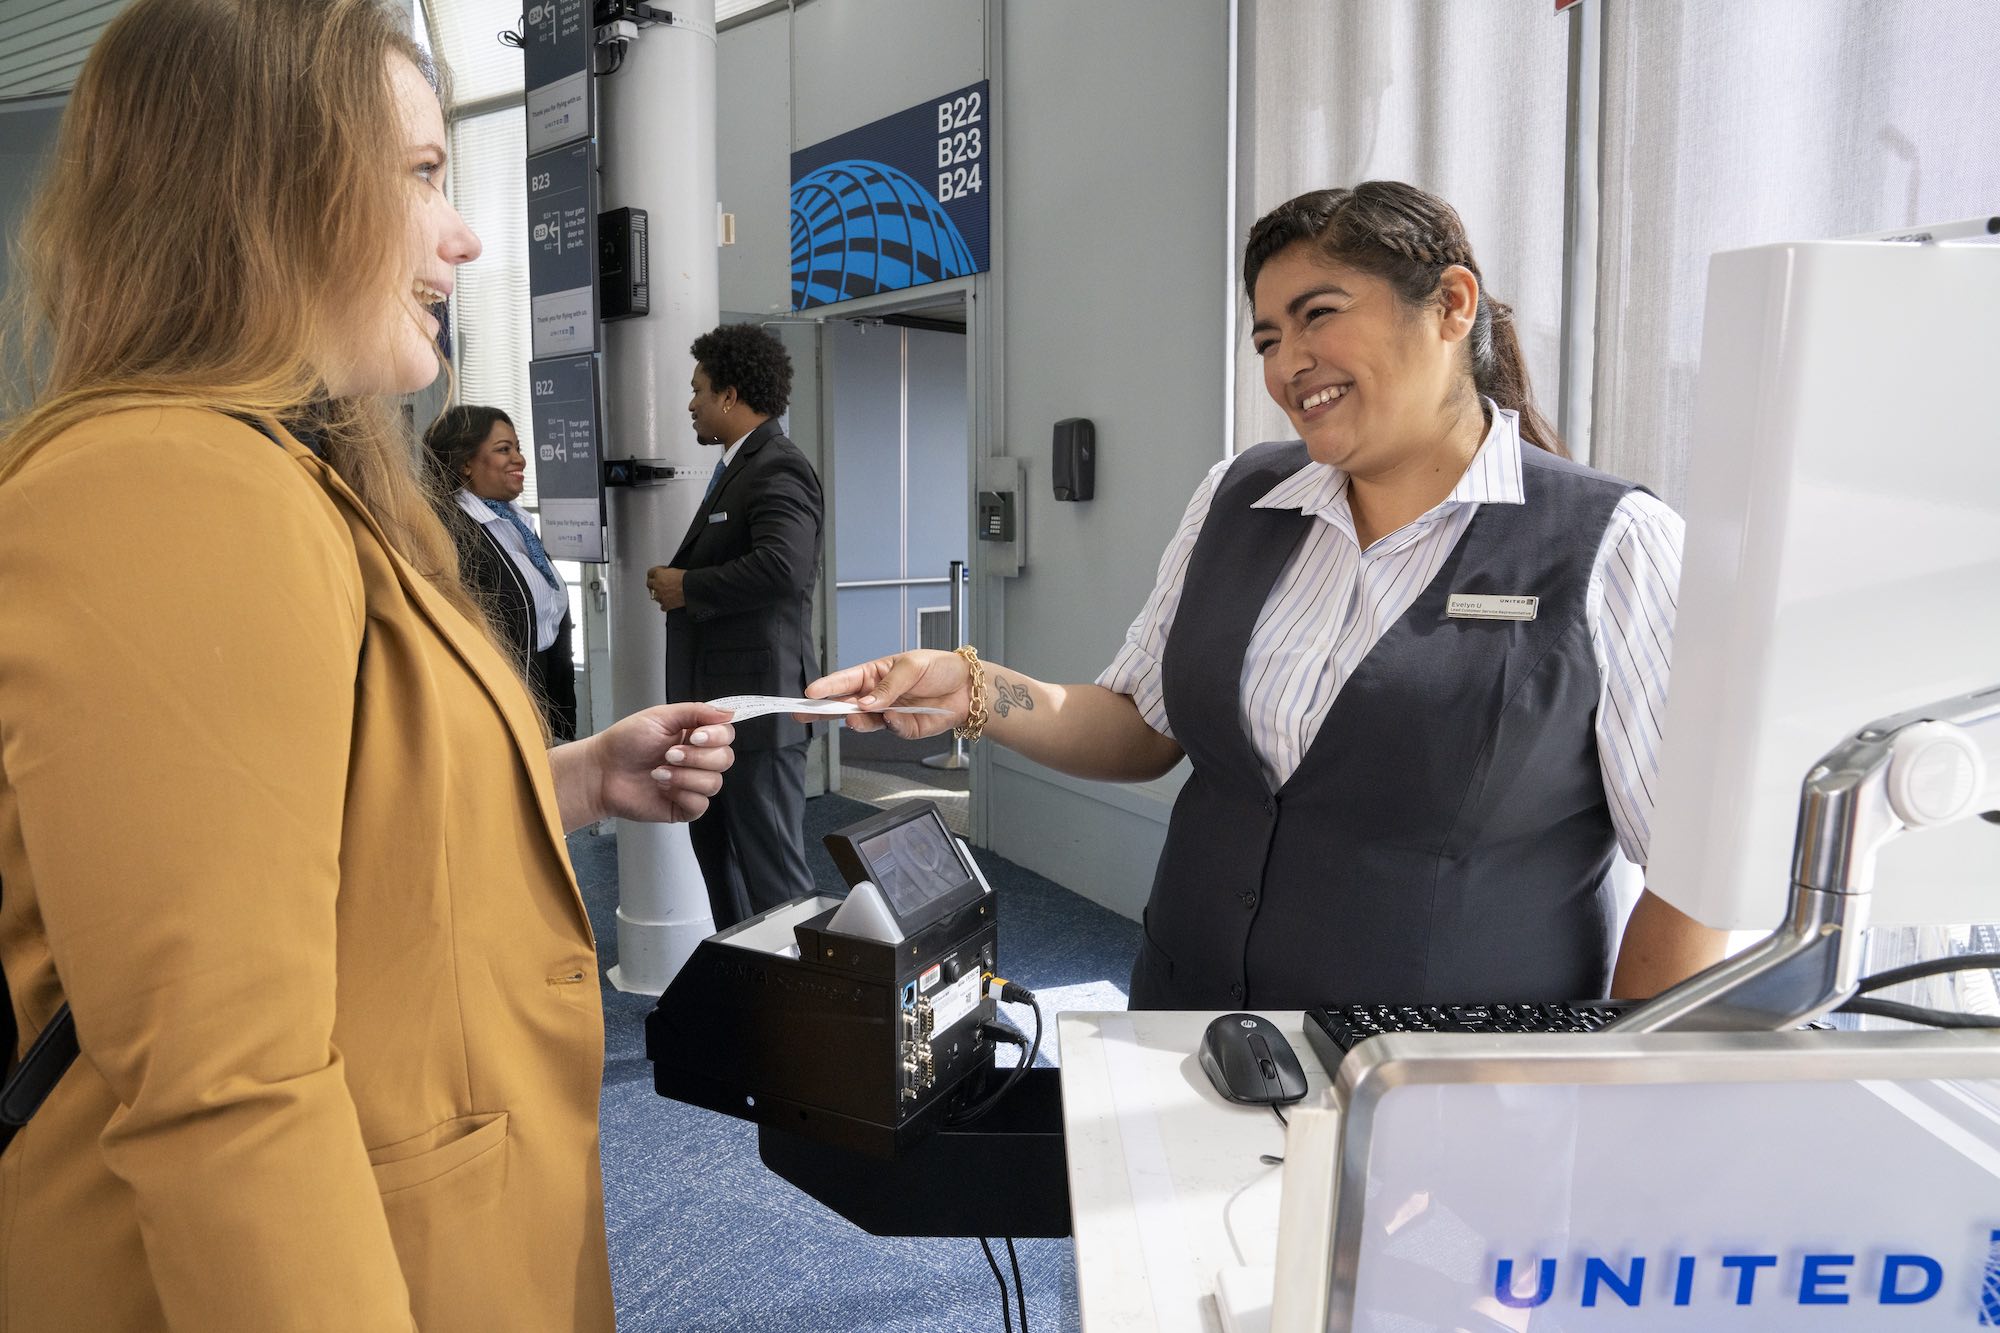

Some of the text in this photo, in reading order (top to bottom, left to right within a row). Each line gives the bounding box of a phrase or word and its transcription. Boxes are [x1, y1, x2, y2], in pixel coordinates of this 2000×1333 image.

[938, 92, 981, 133] B22
[938, 127, 981, 168] B23
[532, 172, 550, 192] B23
[938, 163, 981, 203] B24
[535, 379, 554, 396] B22
[541, 448, 553, 458] B22
[1494, 1254, 1944, 1308] UNITED
